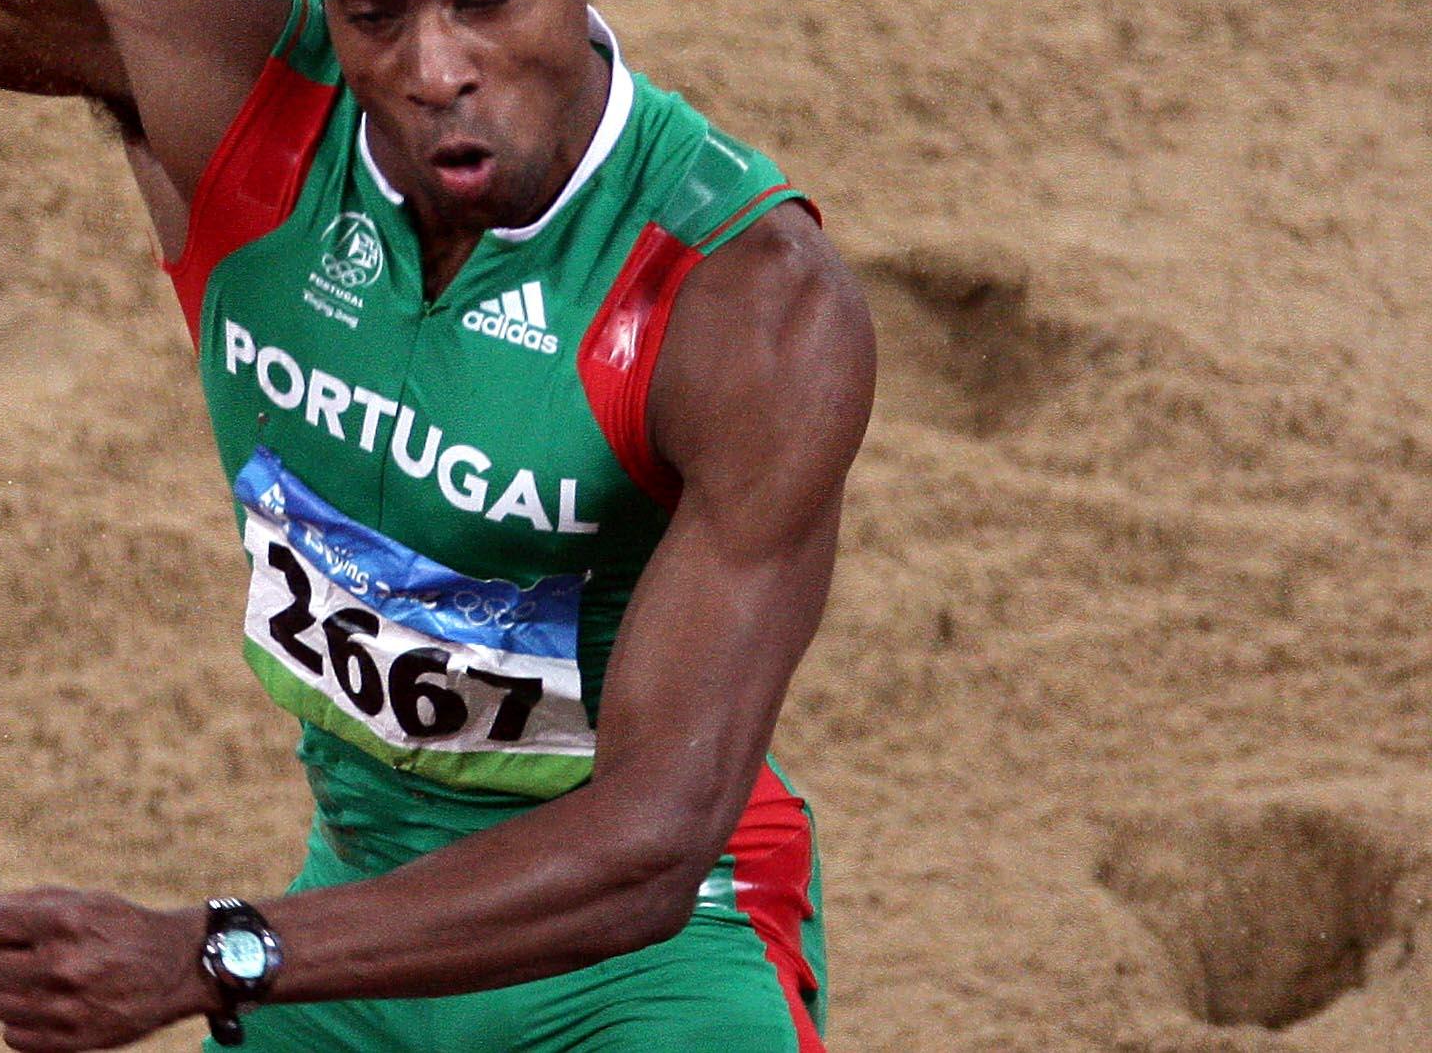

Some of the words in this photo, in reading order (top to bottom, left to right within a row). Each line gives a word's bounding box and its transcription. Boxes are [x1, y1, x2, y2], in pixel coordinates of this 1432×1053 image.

[225, 318, 600, 535] PORTUGAL
[461, 310, 559, 354] adidas
[268, 542, 544, 742] 2667
